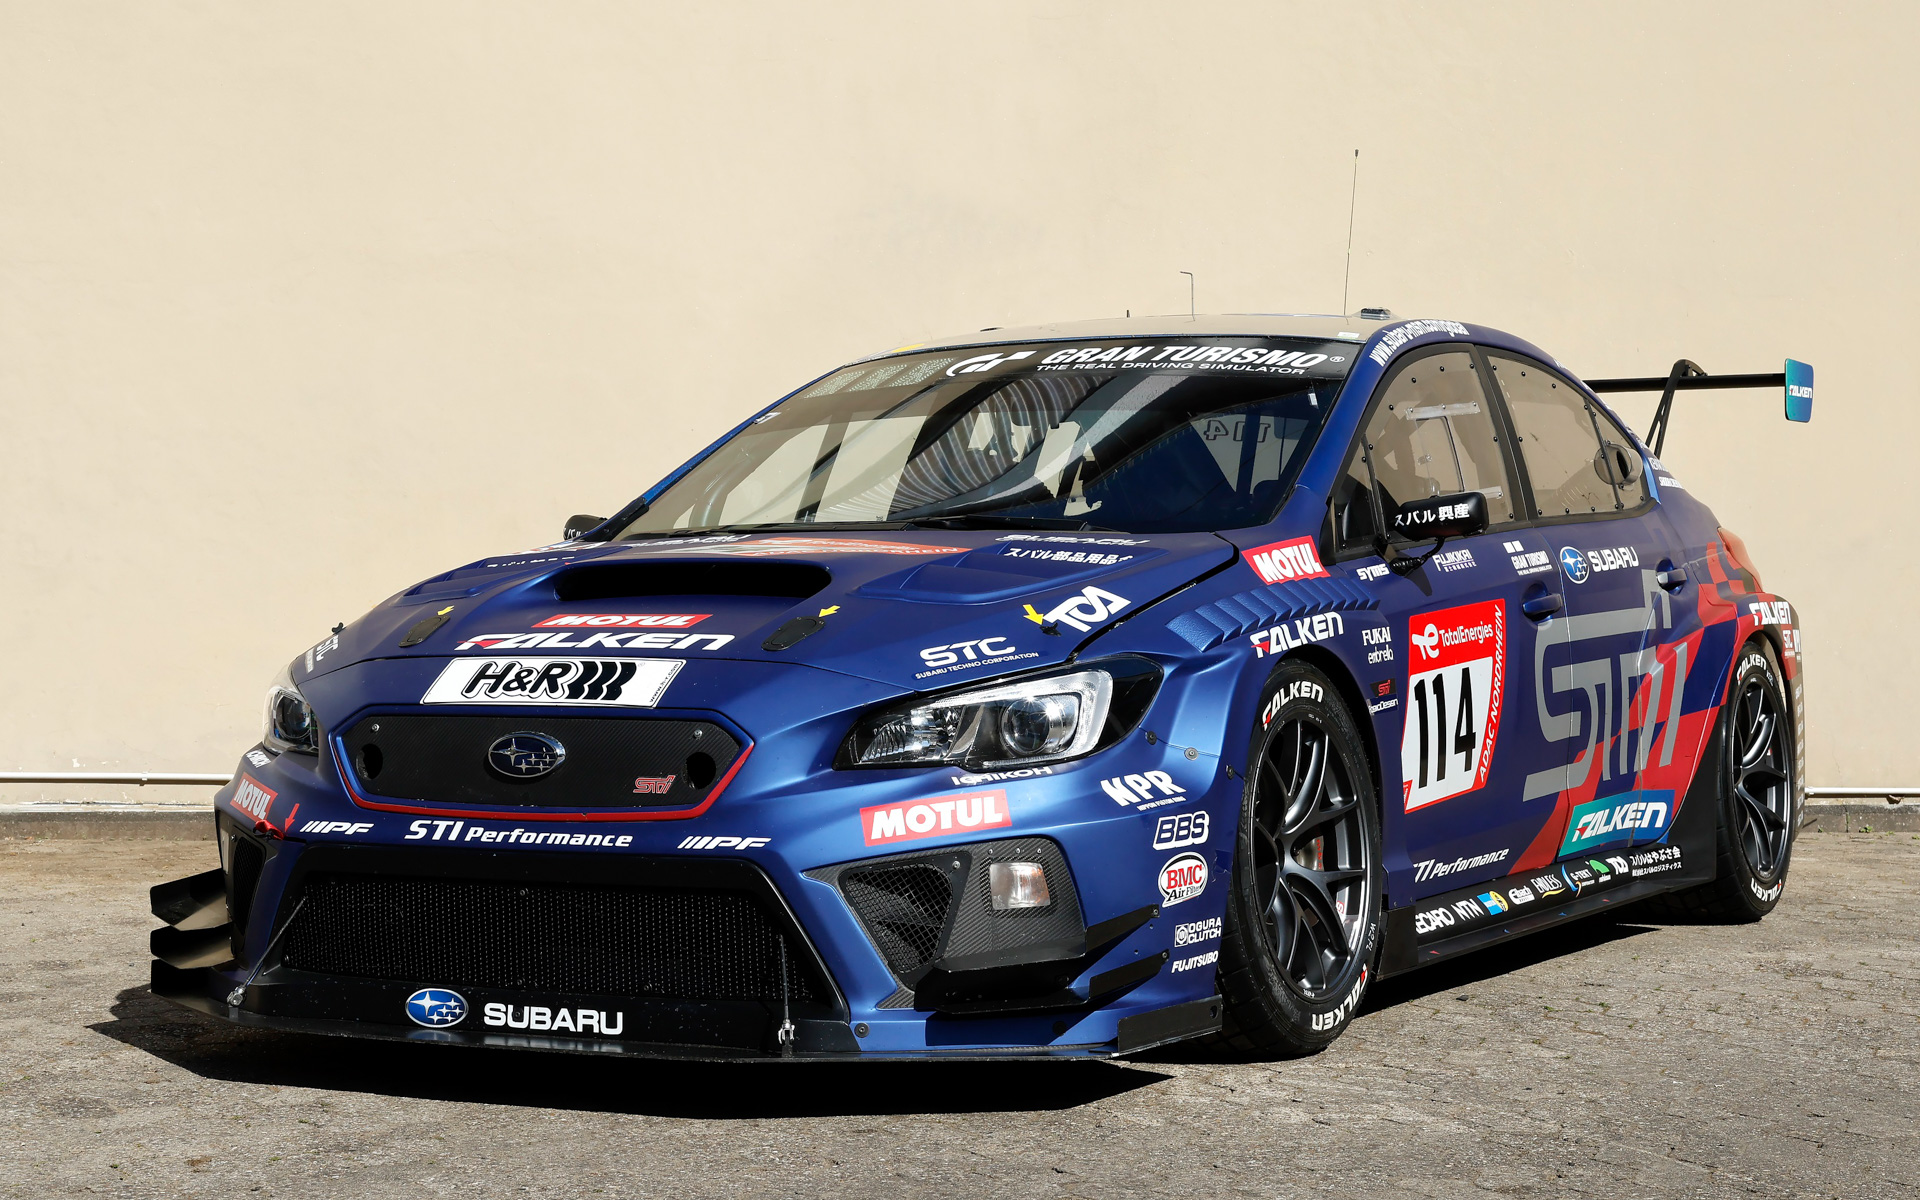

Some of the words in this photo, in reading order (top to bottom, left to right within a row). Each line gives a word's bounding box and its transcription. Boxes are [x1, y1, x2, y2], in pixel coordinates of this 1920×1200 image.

[1041, 346, 1154, 364] GRAN
[1151, 346, 1328, 368] TURISMO
[1198, 363, 1305, 374] SIMULATOR
[1789, 384, 1812, 399] FALKEN
[1395, 509, 1436, 527] スバル
[1253, 543, 1323, 582] MOTUL
[1587, 546, 1639, 573] SUBARU
[542, 614, 697, 627] MOTUL
[1749, 601, 1792, 627] FALKEN
[454, 631, 736, 652] FALKEN
[1250, 611, 1344, 659] FALKEN
[1361, 626, 1392, 646] FUKAI
[1439, 621, 1494, 649] TotalEnergies
[915, 666, 949, 680] SUBARU
[947, 660, 982, 674] TECHNO
[981, 651, 1039, 667] CORPORATION
[919, 636, 1016, 668] STC
[463, 661, 578, 700] H&R
[1736, 653, 1768, 686] FALKEN
[1261, 680, 1324, 732] FALKEN
[1479, 722, 1496, 783] ADAC
[1490, 604, 1503, 719] NORDRHEIN
[1413, 667, 1477, 789] 114
[234, 778, 271, 820] MOTUL
[870, 796, 1004, 840] MOTUL
[1155, 813, 1206, 845] BBS
[1571, 801, 1668, 843] FALKEN
[404, 819, 464, 842] STI
[465, 826, 633, 848] Performance
[1166, 863, 1203, 890] BMC
[1413, 858, 1436, 884] TI
[1429, 848, 1510, 880] Performance
[1167, 889, 1186, 903] Air
[1751, 877, 1782, 902] FALKEN
[1450, 898, 1485, 921] NTN
[1188, 916, 1222, 933] OGURA
[1188, 927, 1221, 944] CLUTCH
[1171, 950, 1219, 974] FUJITSUBO
[1311, 963, 1369, 1031] FALKEN
[483, 1002, 623, 1036] SUBARU
